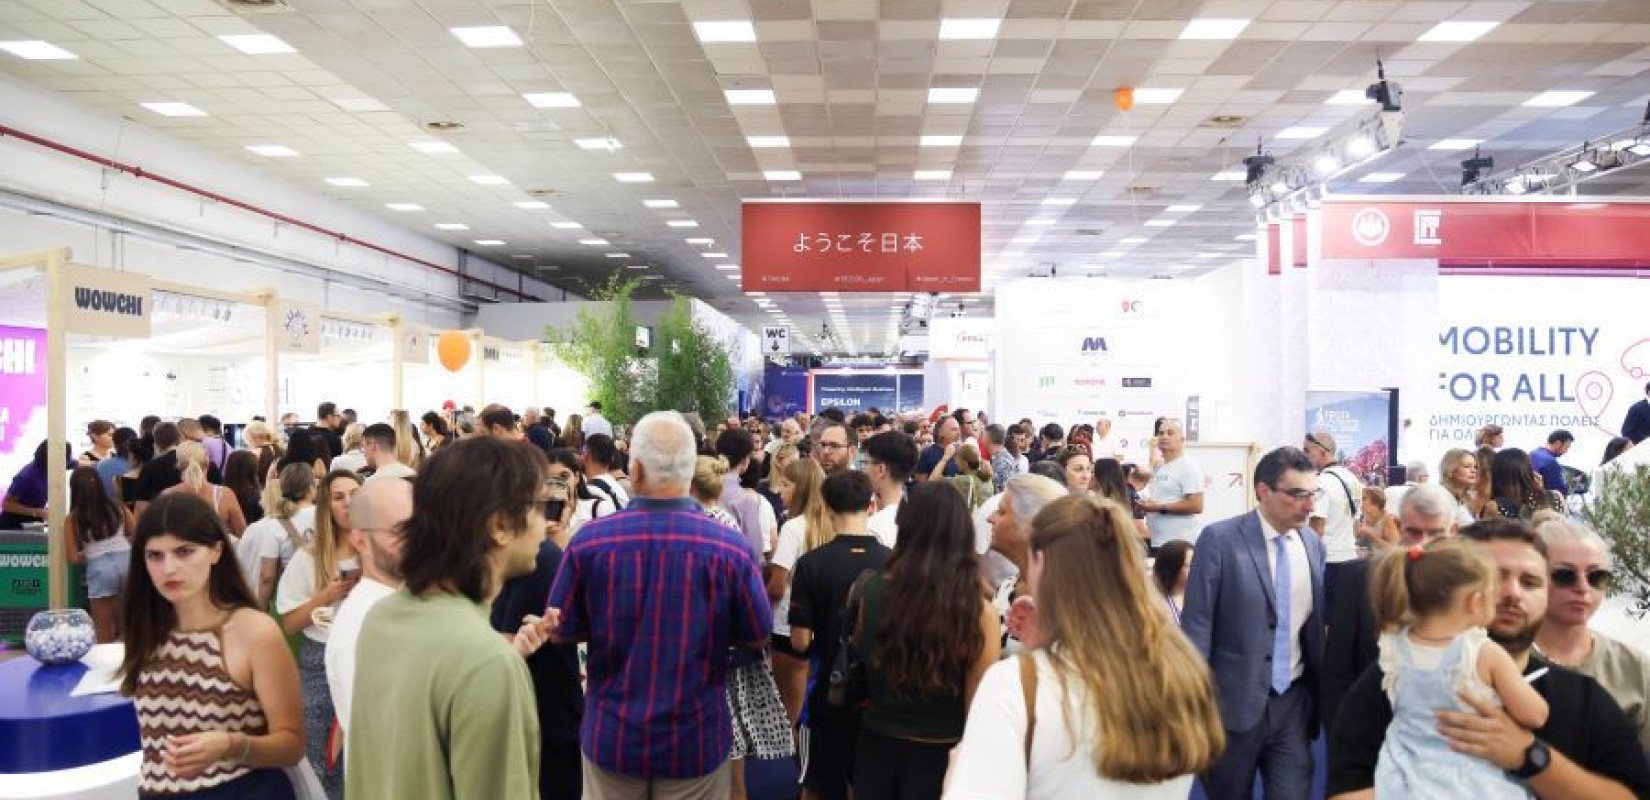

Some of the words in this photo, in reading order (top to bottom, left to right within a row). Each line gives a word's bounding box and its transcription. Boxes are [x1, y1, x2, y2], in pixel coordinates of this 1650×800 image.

[793, 232, 924, 253] ようこそ日本
[74, 286, 142, 316] WOWCHI
[765, 327, 787, 339] WC
[1439, 326, 1600, 355] MOBILITY
[1512, 373, 1576, 402] ALL
[1429, 428, 1449, 441] ΓΙΑ
